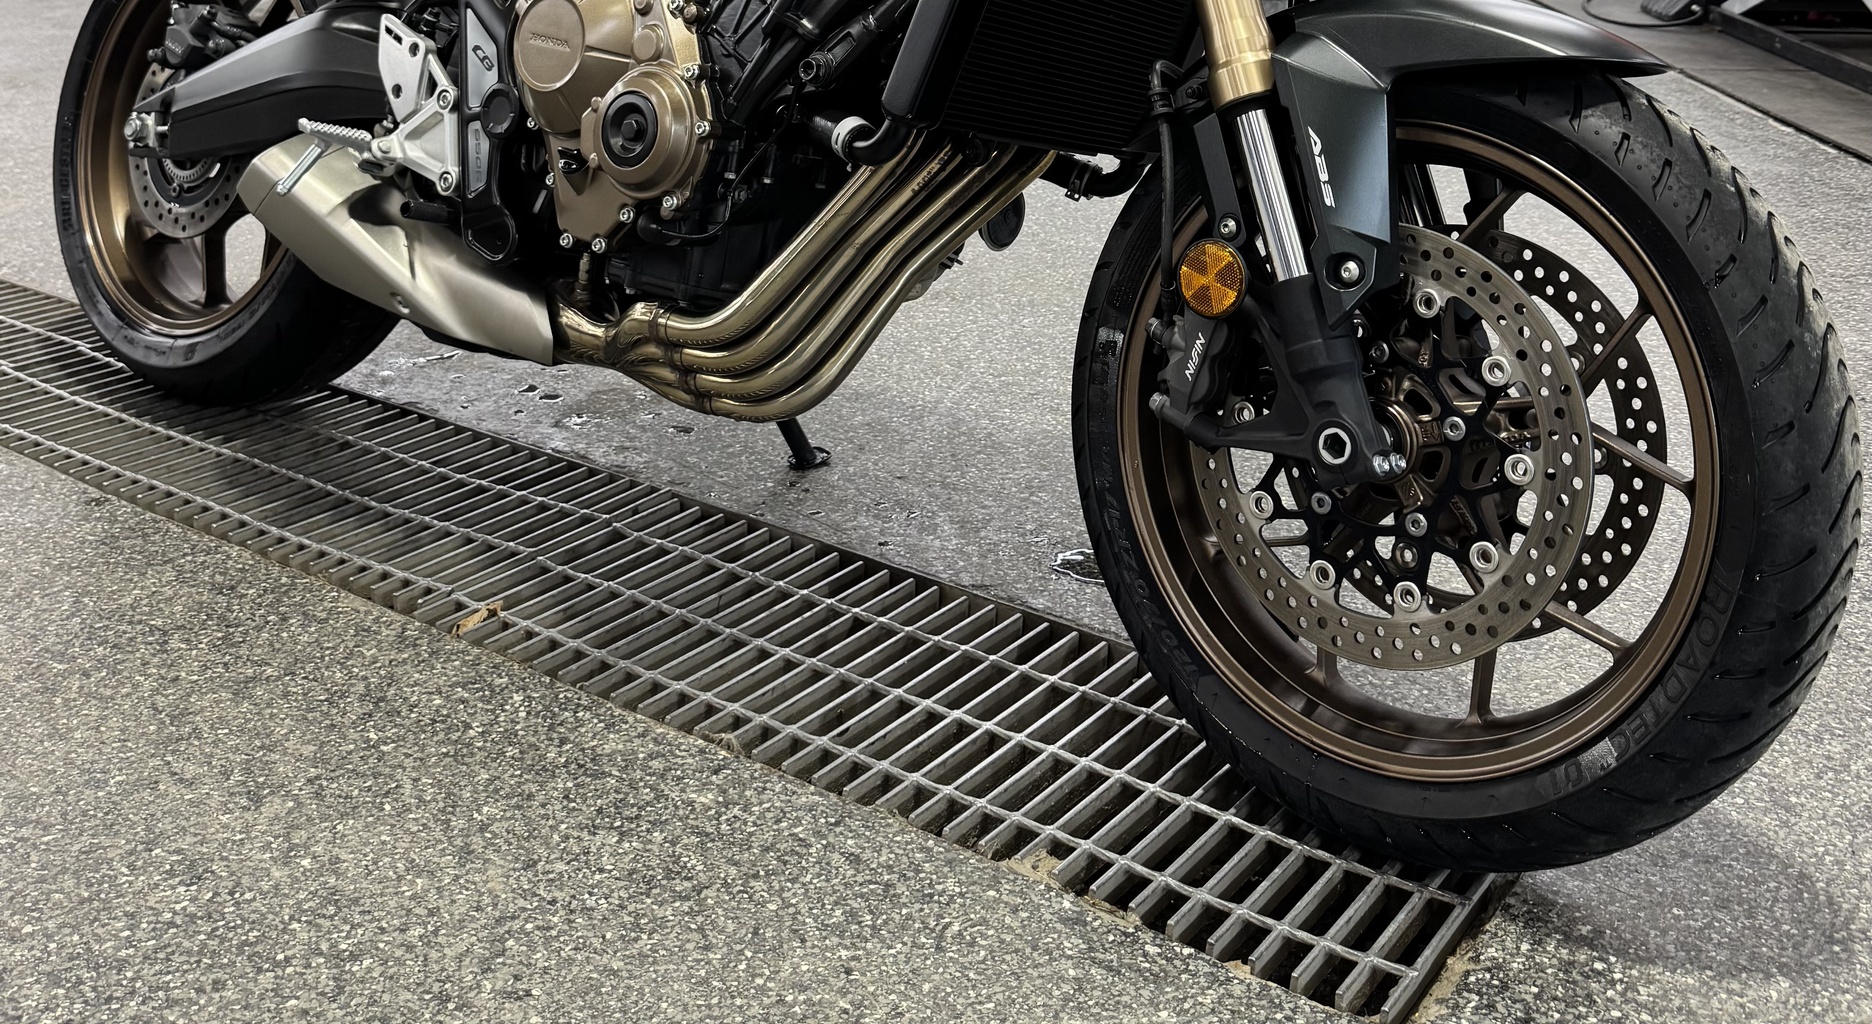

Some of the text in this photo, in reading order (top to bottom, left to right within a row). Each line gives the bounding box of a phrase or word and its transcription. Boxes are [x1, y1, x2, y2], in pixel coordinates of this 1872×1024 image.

[472, 44, 495, 72] CB
[530, 32, 571, 51] HONDA
[1307, 126, 1336, 208] ABS
[1607, 580, 1734, 761] ROADTEC
